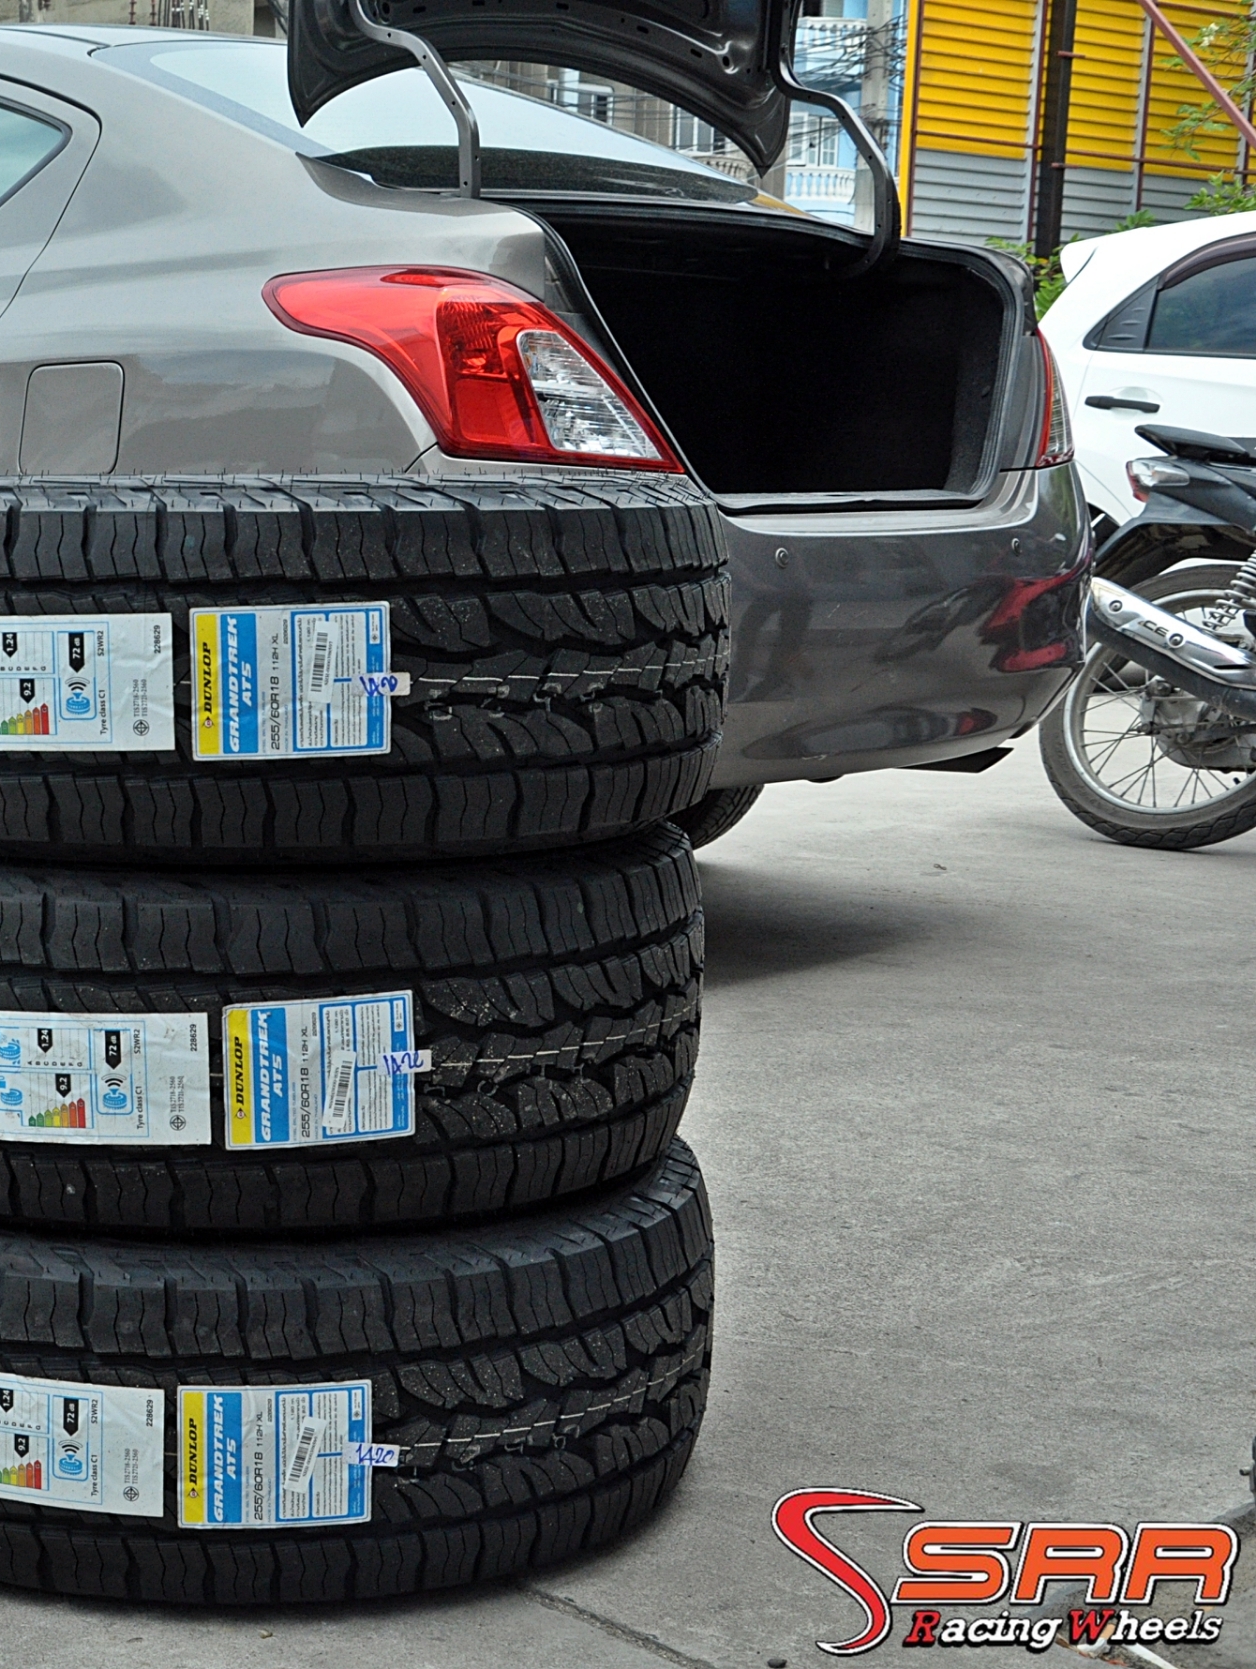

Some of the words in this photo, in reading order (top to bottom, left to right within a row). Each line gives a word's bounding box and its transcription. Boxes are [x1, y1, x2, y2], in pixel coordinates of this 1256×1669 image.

[75, 638, 80, 646] dB
[272, 633, 278, 645] XL
[73, 648, 80, 659] 72
[202, 642, 212, 714] DUNLOP
[227, 616, 239, 752] GRANDTREK
[242, 661, 252, 707] AT5
[99, 690, 105, 699] C1
[269, 676, 281, 750] 255/60R18
[100, 719, 108, 735] Tyre
[301, 1026, 308, 1037] XL
[111, 1036, 116, 1044] dB
[109, 1045, 117, 1056] 72
[234, 1036, 244, 1105] DUNLOP
[258, 1011, 271, 1141] GRANDTREK
[272, 1054, 283, 1098] AT5
[136, 1086, 142, 1095] C1
[300, 1068, 311, 1138] 255/60R18
[137, 1115, 145, 1129] Tyre
[70, 1403, 75, 1411] dB
[67, 1413, 75, 1423] 72
[256, 1412, 263, 1422] XL
[91, 1454, 97, 1463] C1
[189, 1418, 197, 1485] DUNLOP
[214, 1394, 223, 1521] GRANDTREK
[227, 1437, 236, 1480] AT5
[253, 1452, 264, 1520] 255/60R18
